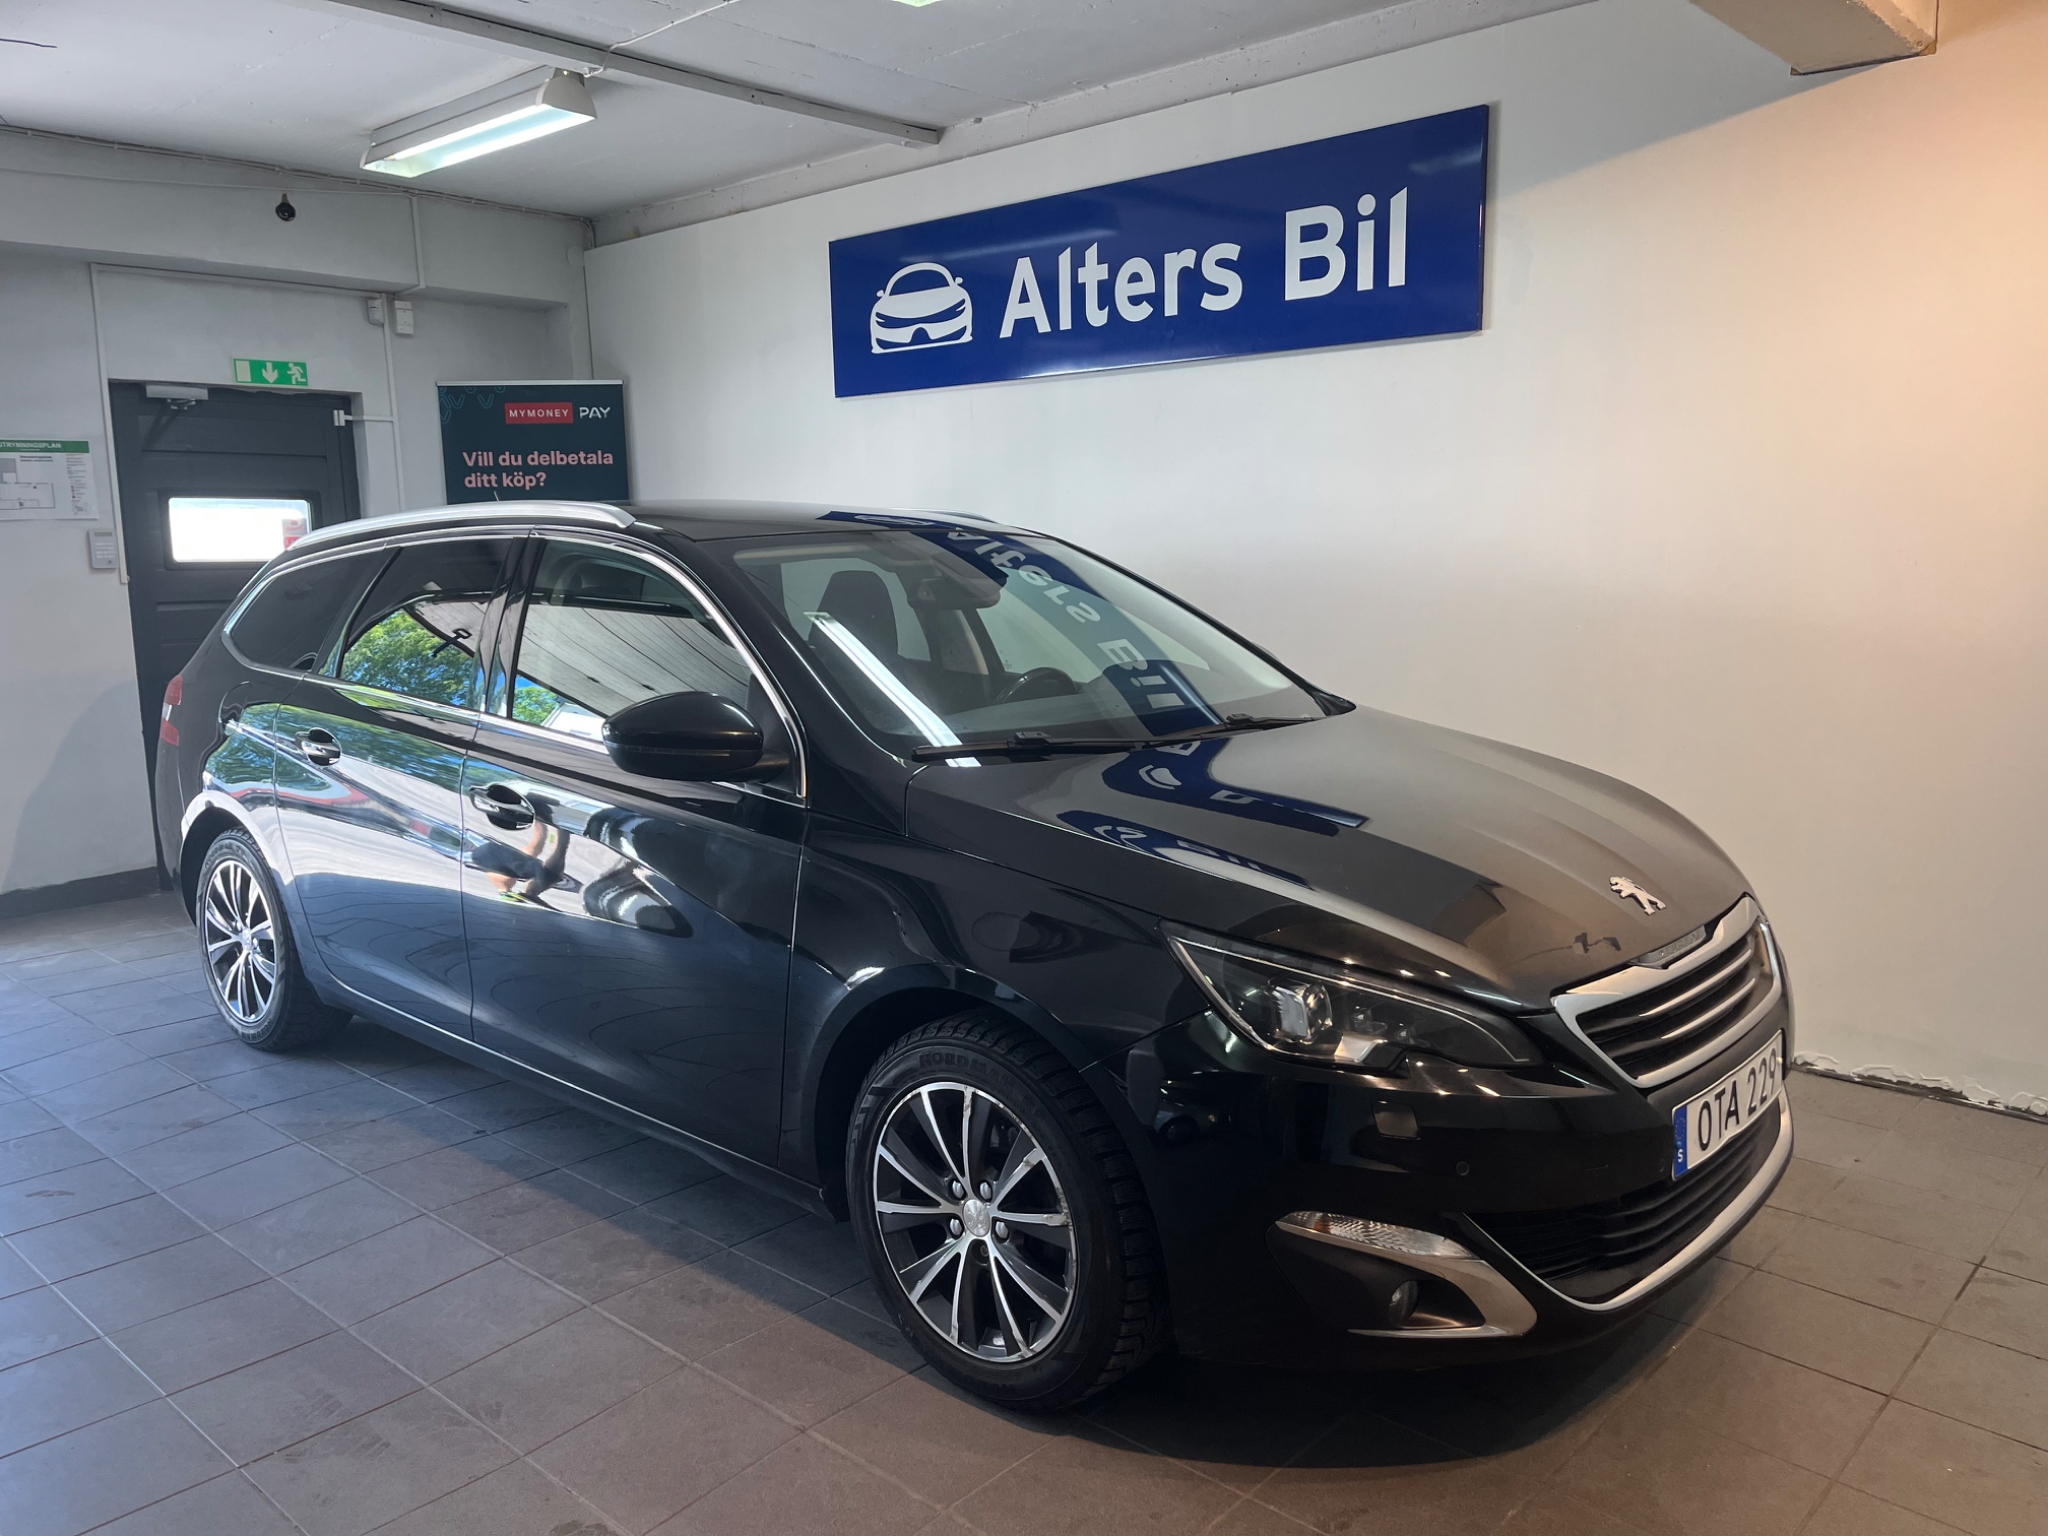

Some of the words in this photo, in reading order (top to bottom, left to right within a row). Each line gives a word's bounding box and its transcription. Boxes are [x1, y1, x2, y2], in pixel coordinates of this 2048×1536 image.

[1000, 242, 1243, 338] Alters
[1285, 186, 1408, 301] Bil
[509, 408, 569, 418] MYMONEY
[579, 406, 611, 419] PAY
[462, 451, 493, 467] Vill
[498, 451, 523, 466] du
[527, 450, 614, 466] delbetala
[464, 472, 498, 488] ditt
[502, 471, 547, 490] köp?
[1698, 1079, 1740, 1151] OTA
[1747, 1048, 1777, 1118] 229
[1677, 1148, 1684, 1163] S
